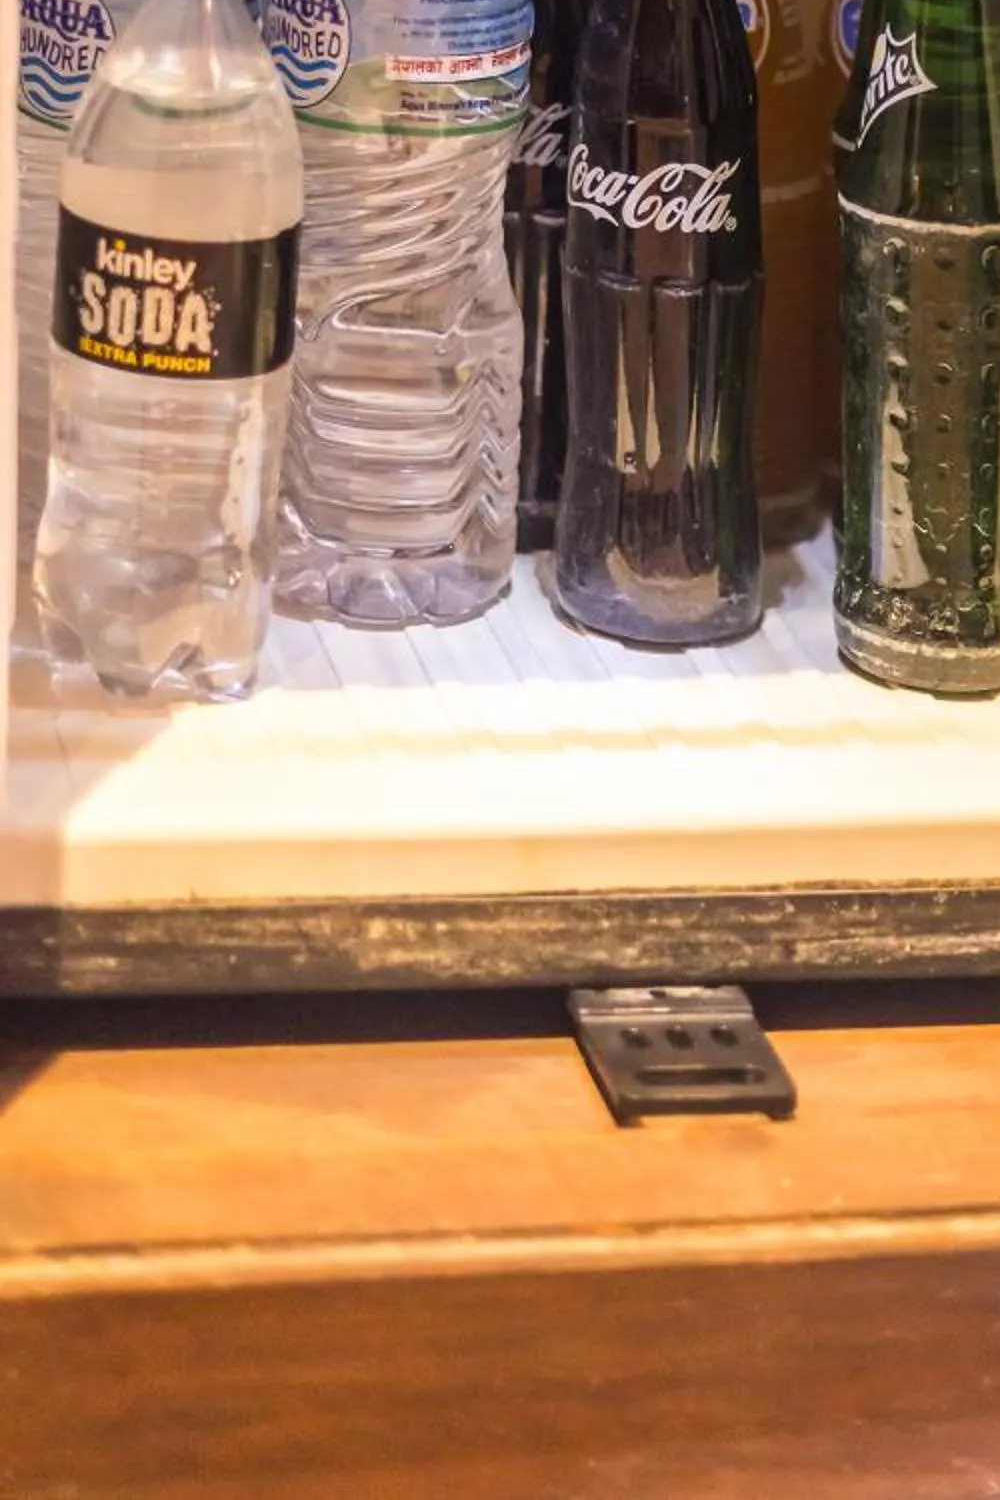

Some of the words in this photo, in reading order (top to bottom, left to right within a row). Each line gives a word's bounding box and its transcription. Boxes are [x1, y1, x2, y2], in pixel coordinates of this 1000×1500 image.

[566, 143, 741, 233] Coca-Cola
[97, 238, 197, 291] kinley
[79, 272, 214, 354] SODA
[80, 335, 138, 366] EXTRA
[143, 353, 212, 372] PUNCH
